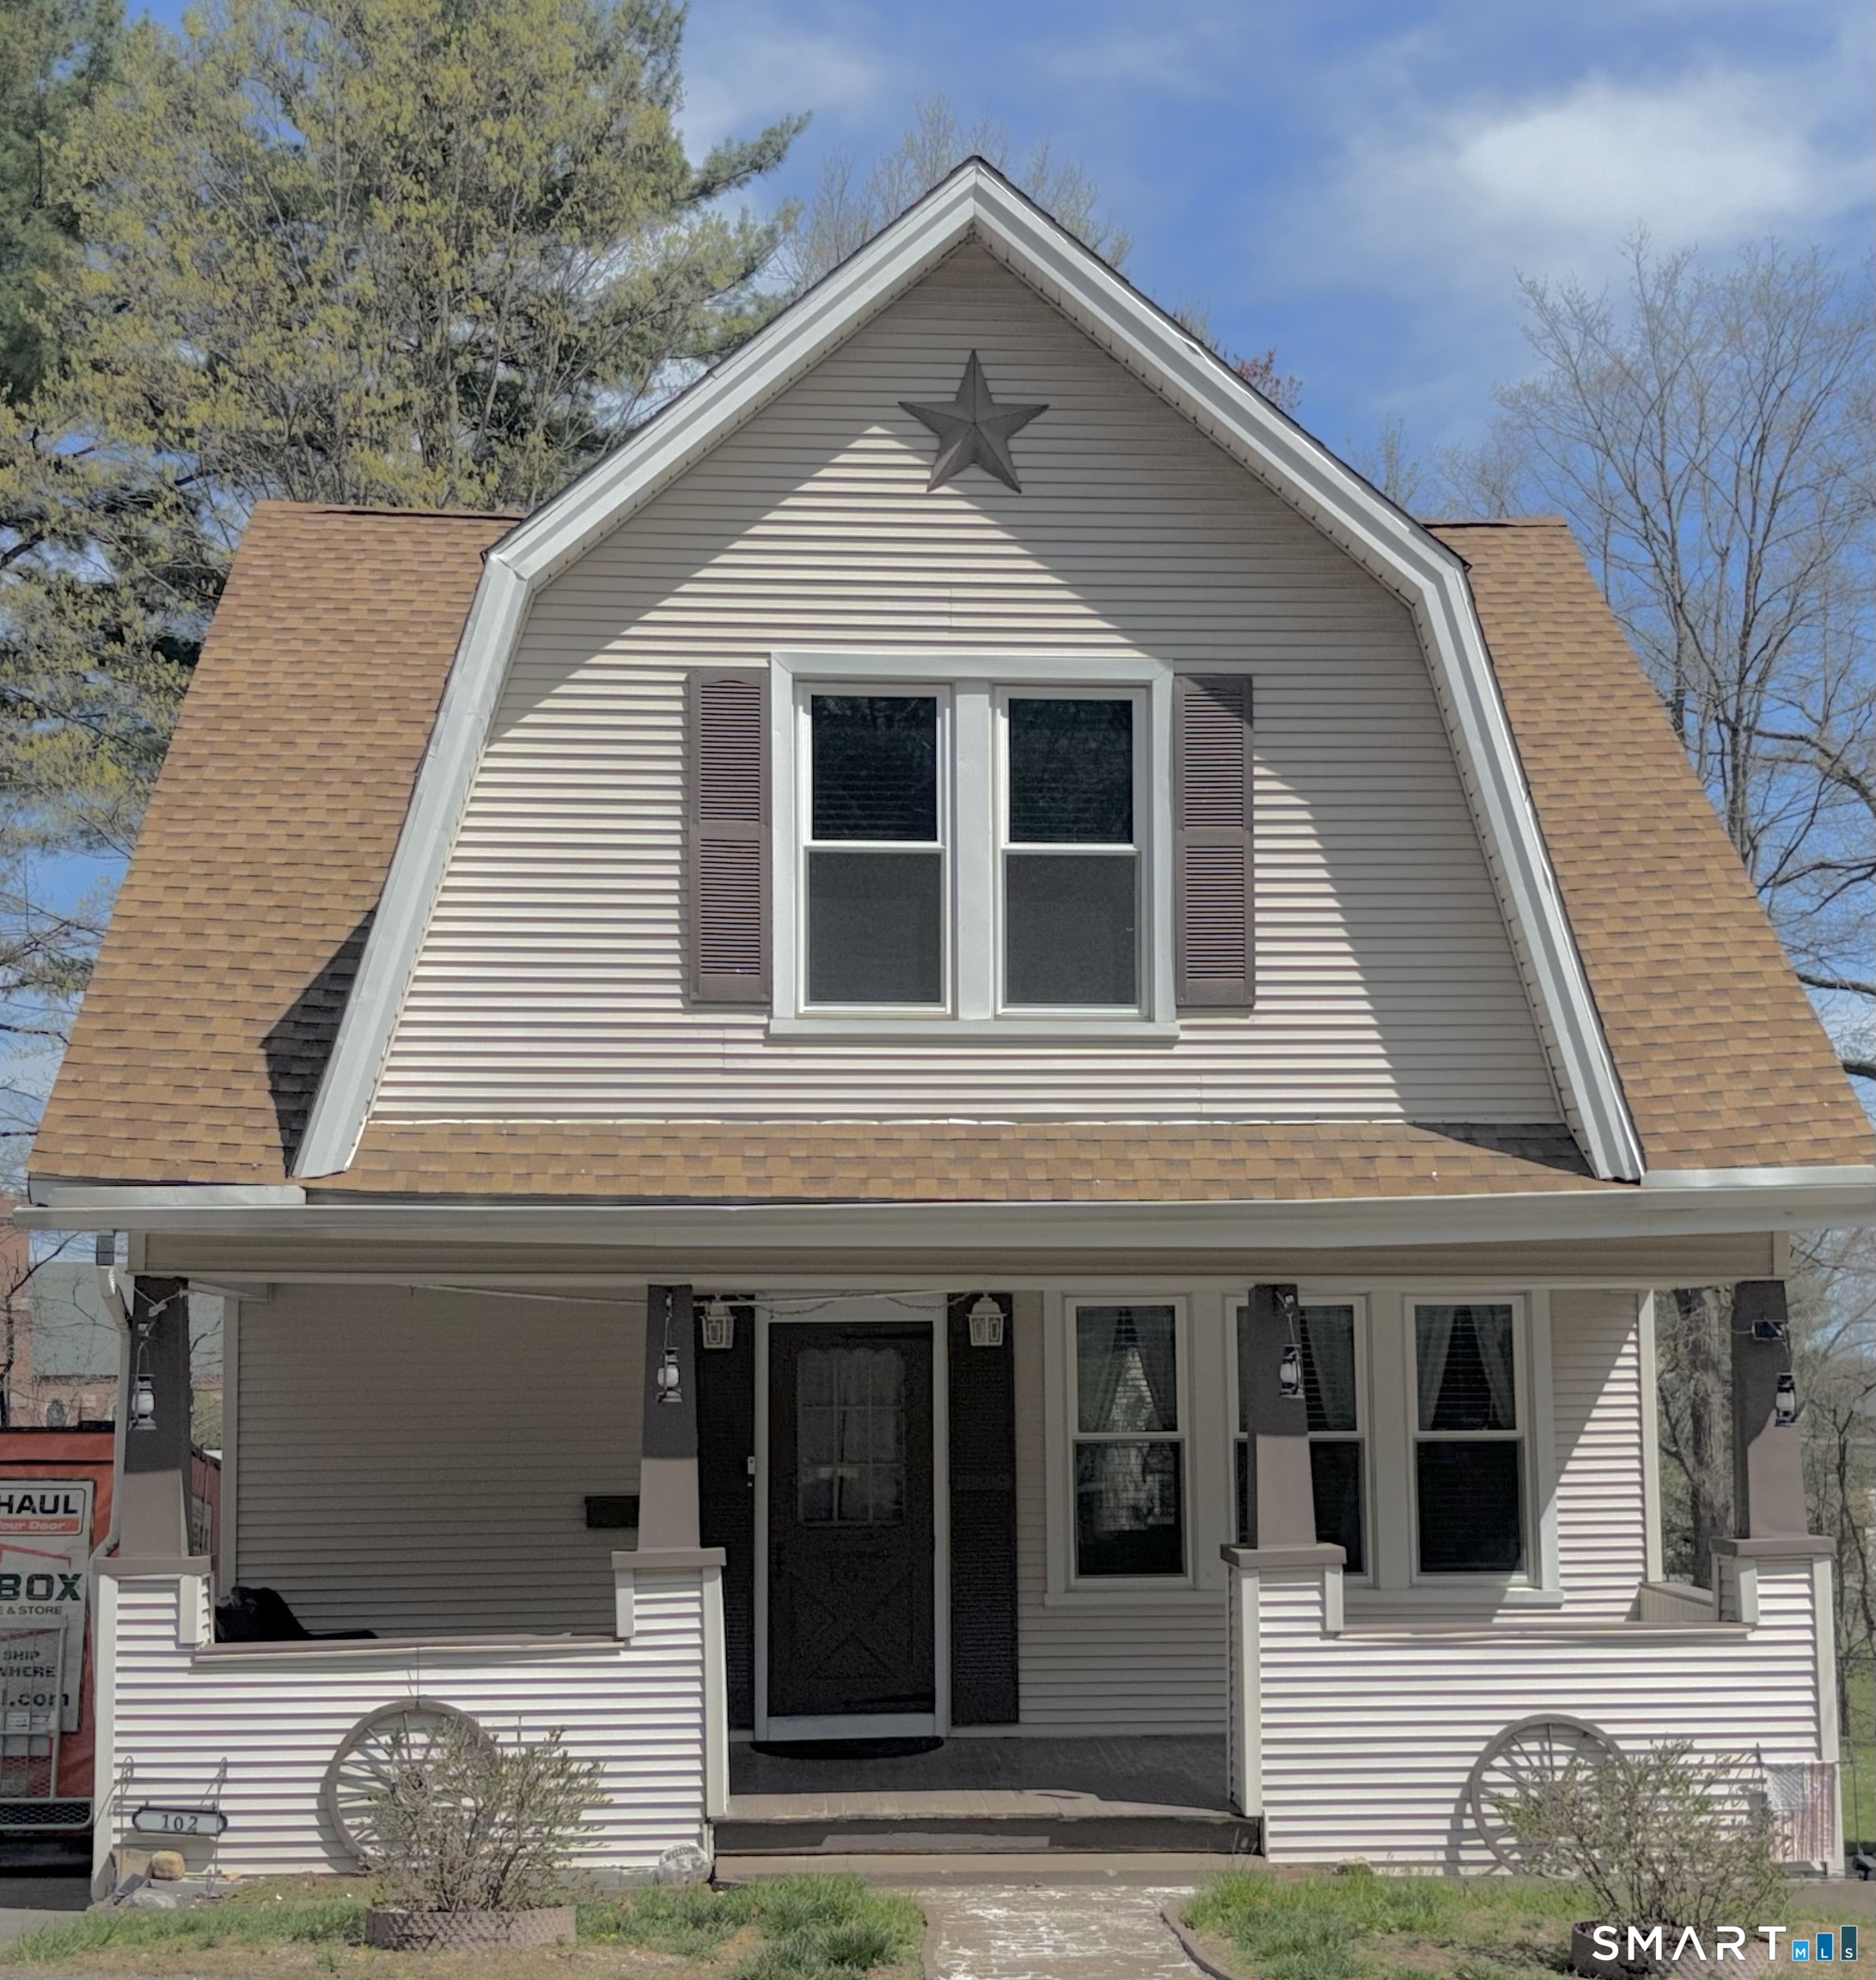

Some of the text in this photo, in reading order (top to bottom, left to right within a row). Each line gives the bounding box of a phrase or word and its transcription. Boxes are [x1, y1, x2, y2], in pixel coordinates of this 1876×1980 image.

[0, 1494, 78, 1514] HAUL
[28, 1520, 66, 1531] Door
[0, 1573, 82, 1601] BOX
[7, 1606, 15, 1615] &
[18, 1605, 64, 1616] STORE
[3, 1650, 40, 1661] SHIP
[162, 1813, 199, 1832] 102
